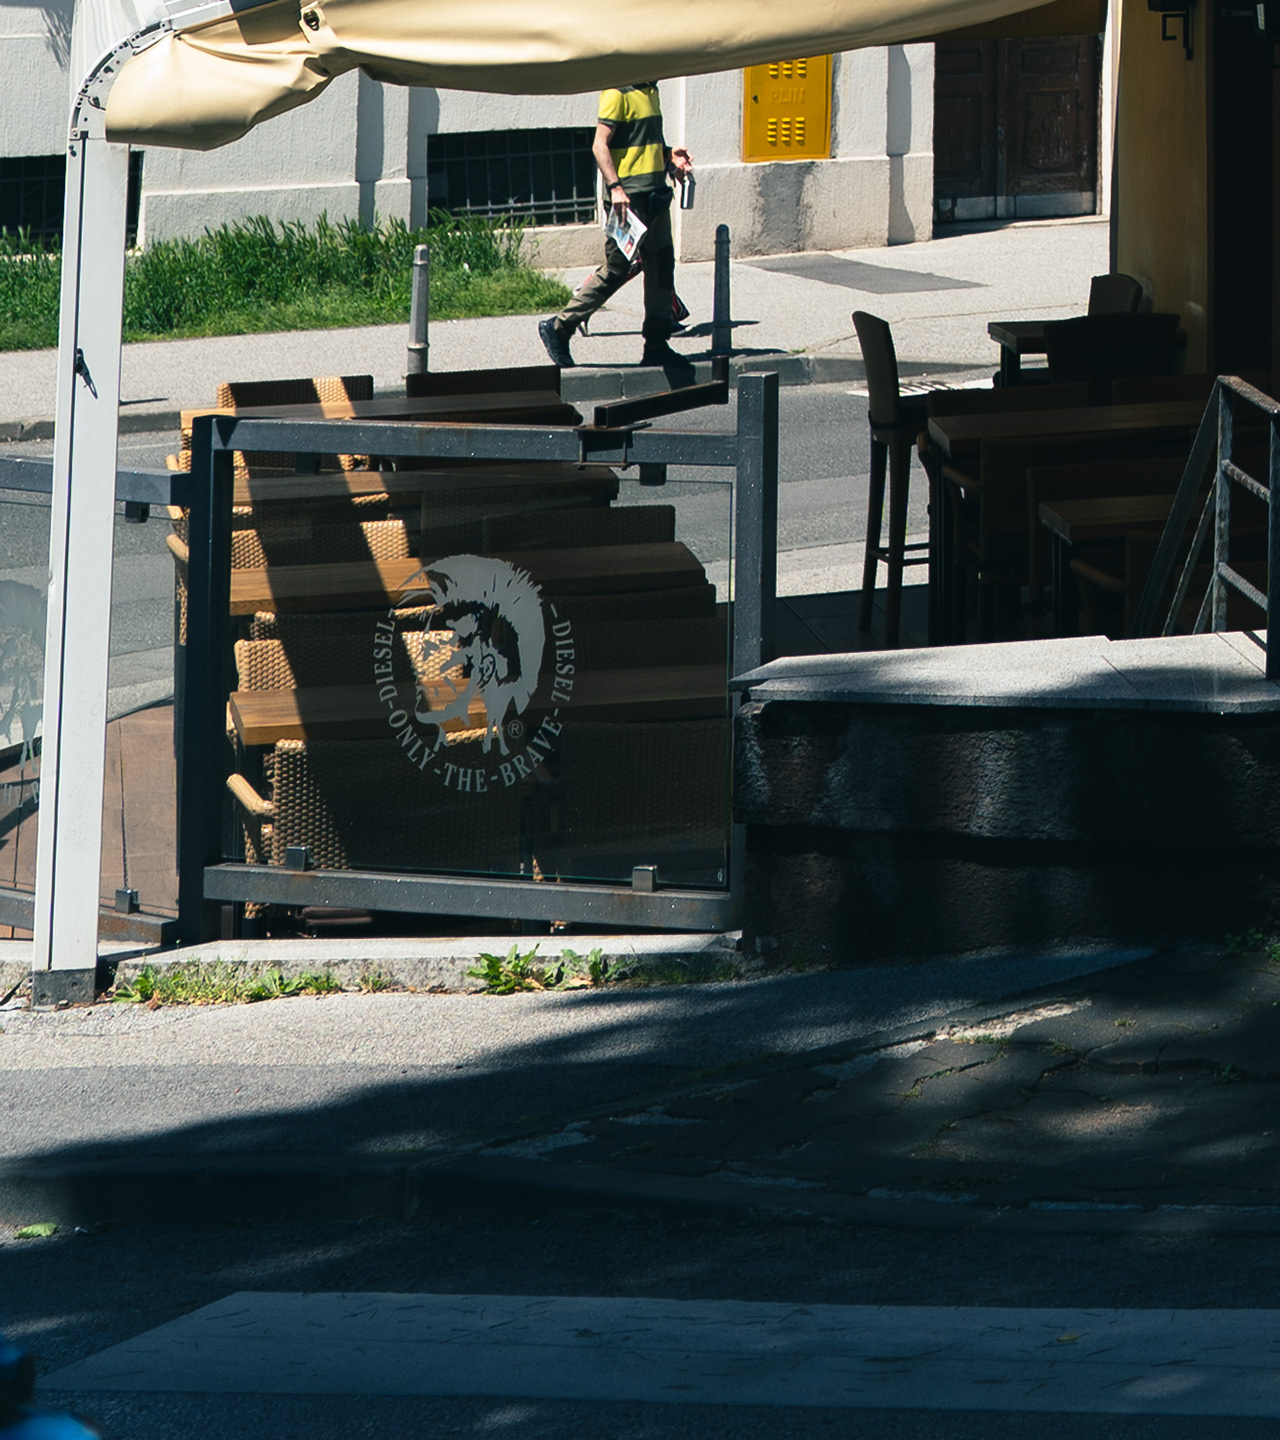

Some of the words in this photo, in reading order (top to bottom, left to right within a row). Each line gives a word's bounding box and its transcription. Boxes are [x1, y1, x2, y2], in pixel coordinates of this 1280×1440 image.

[769, 87, 805, 105] PLIN
[373, 621, 397, 702] DIESEL
[551, 620, 576, 702] DIESEL
[388, 709, 436, 771] ONLY
[443, 762, 488, 793] THE
[500, 717, 562, 787] BRAVE
